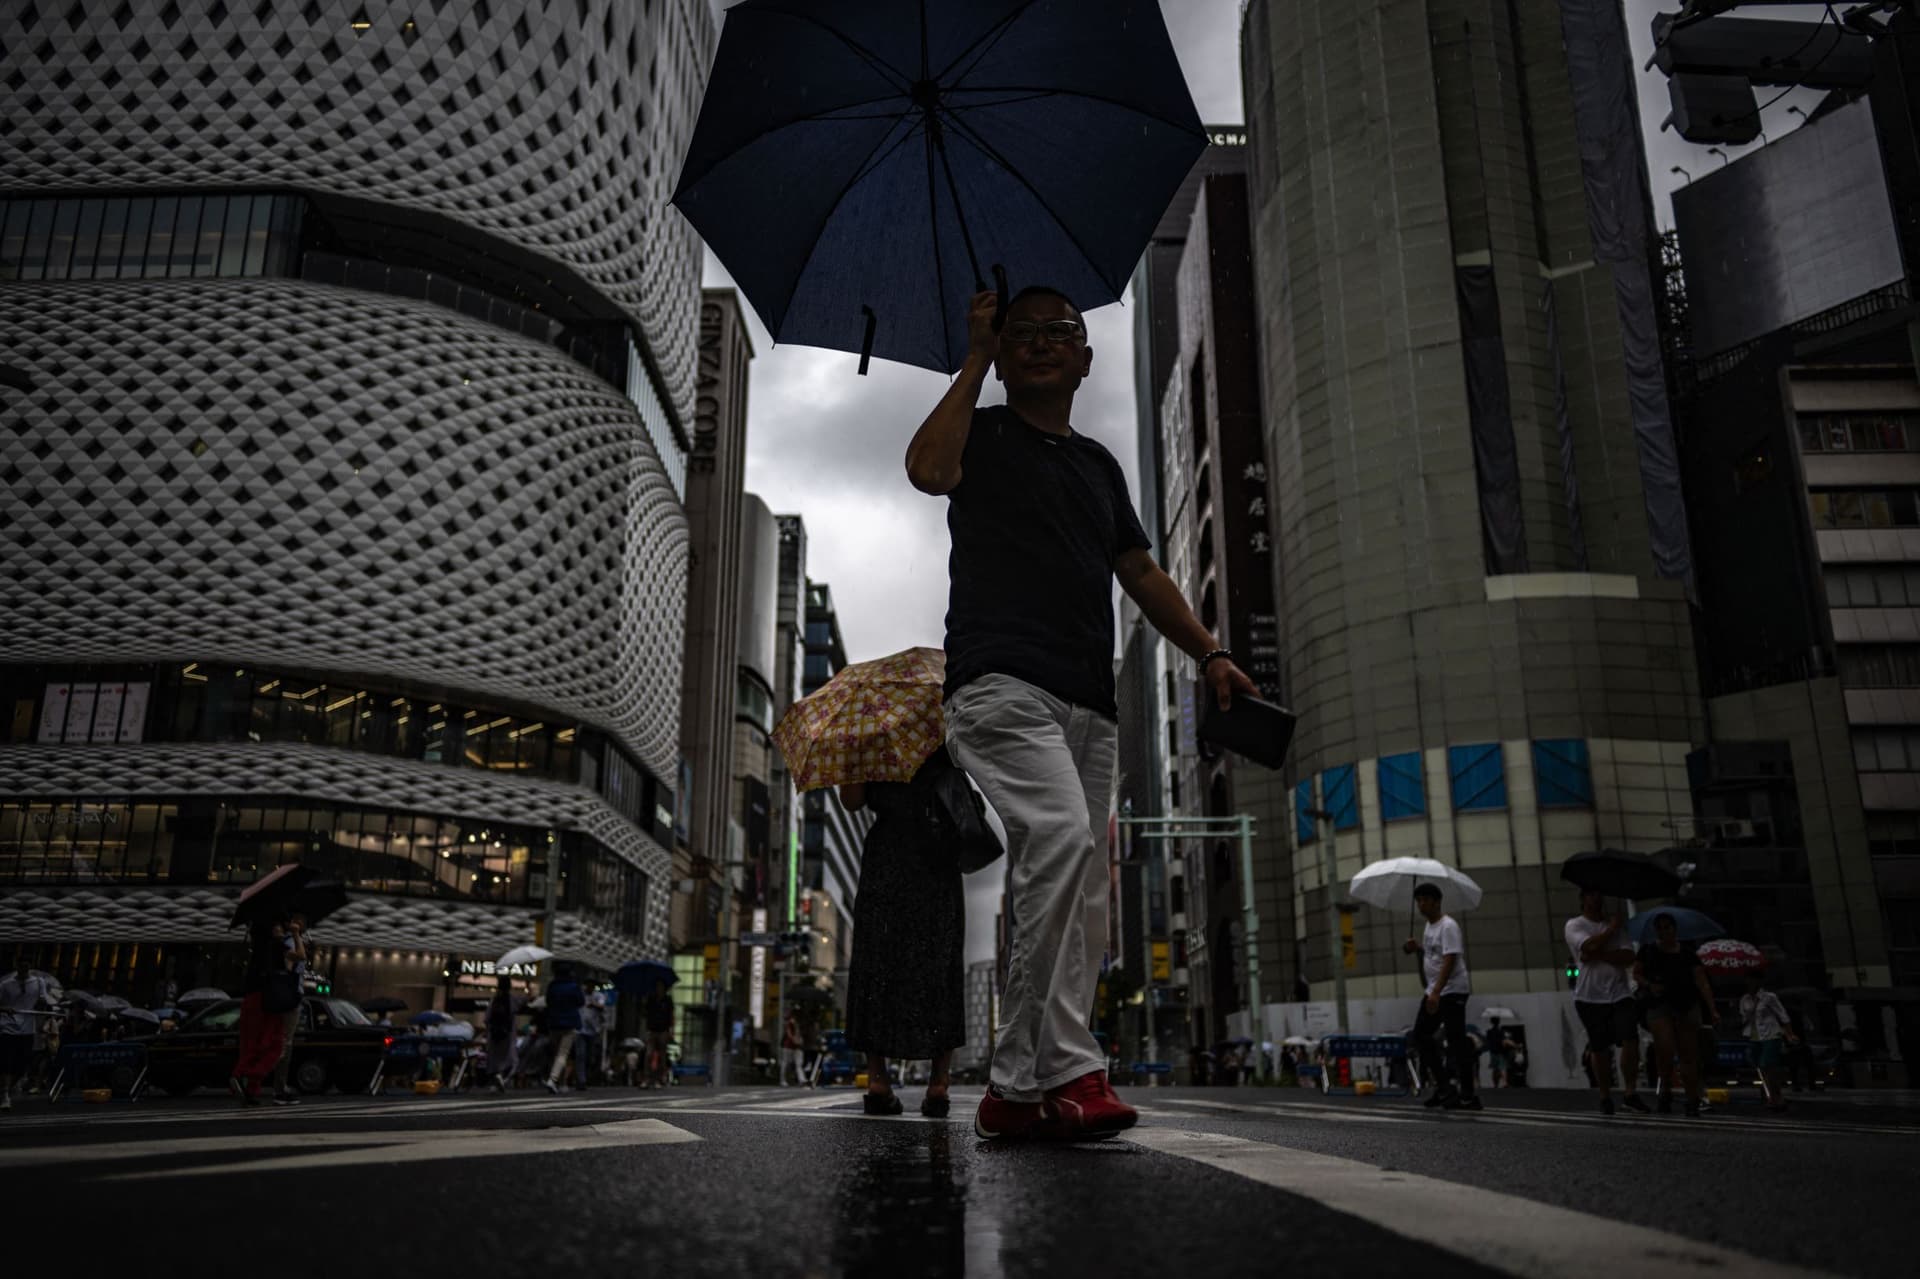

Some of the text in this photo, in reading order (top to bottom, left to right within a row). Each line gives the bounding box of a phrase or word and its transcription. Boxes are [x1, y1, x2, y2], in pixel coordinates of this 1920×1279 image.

[690, 303, 722, 473] GINZA CORE
[461, 960, 538, 976] NISSAN
